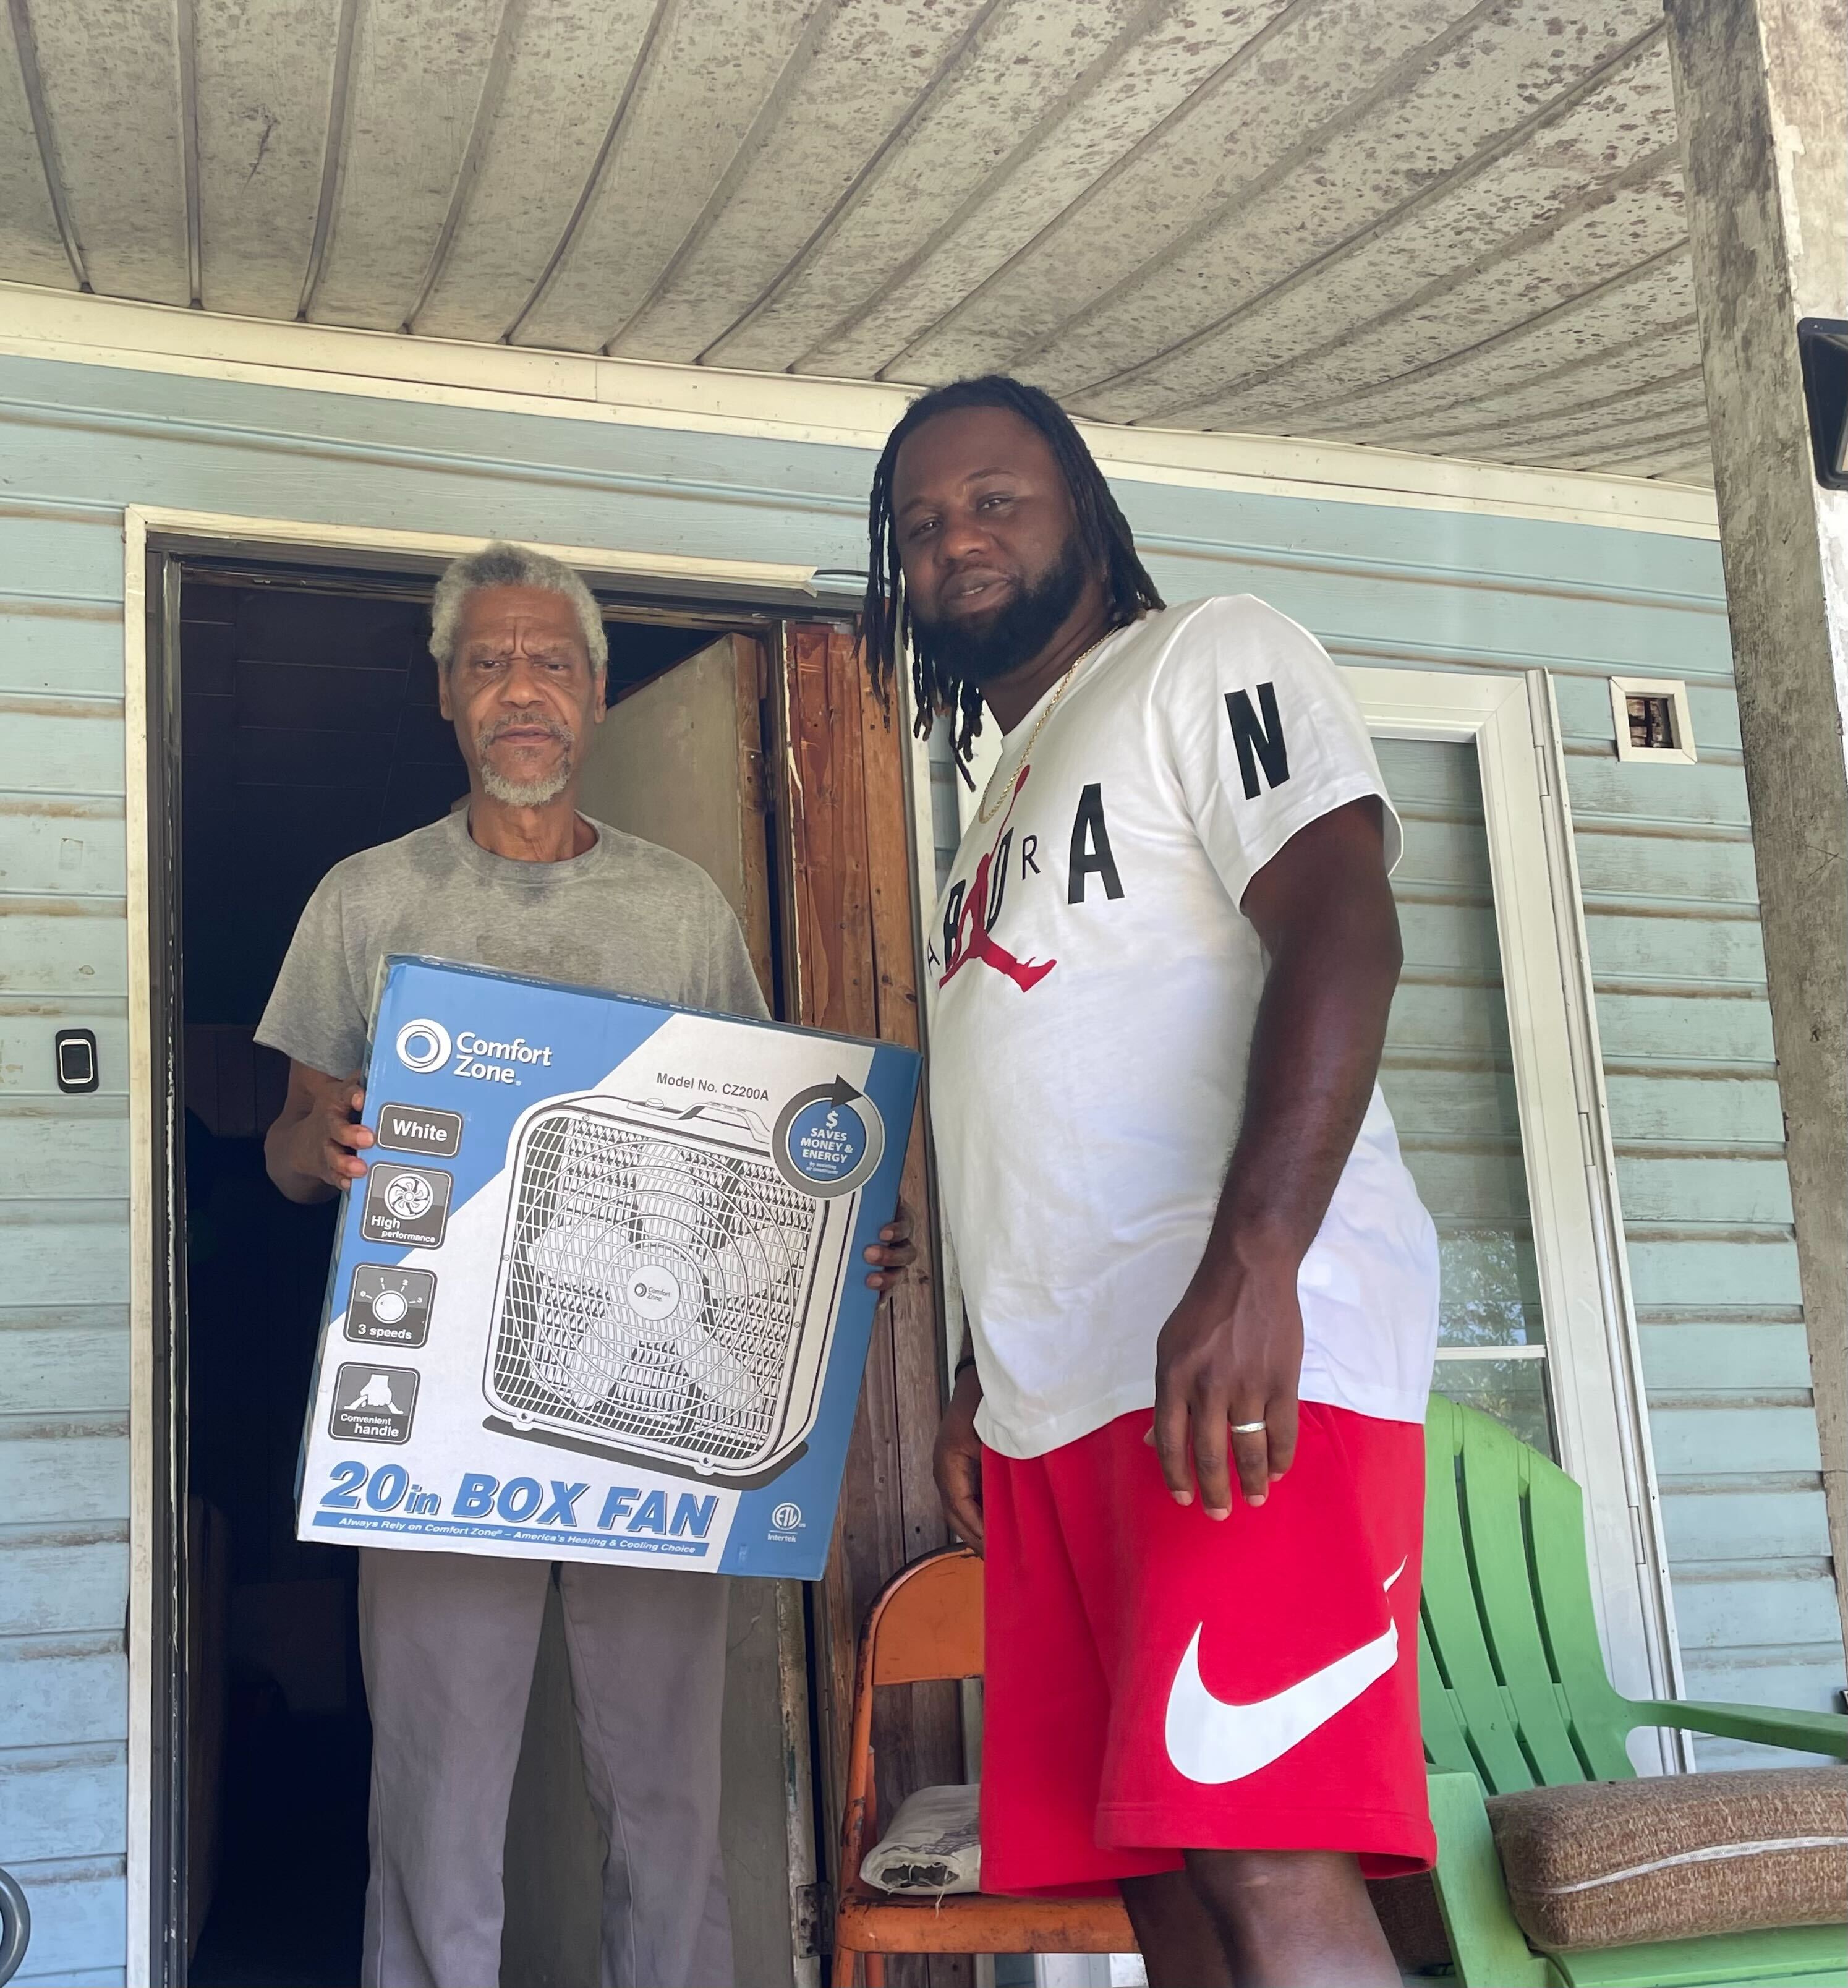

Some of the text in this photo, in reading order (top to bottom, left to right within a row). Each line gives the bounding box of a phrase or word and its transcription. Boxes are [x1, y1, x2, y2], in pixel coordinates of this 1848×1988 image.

[456, 1031, 553, 1067] Comfort
[657, 1072, 769, 1101] Model No. CZ200A
[393, 1119, 448, 1142] White
[811, 1128, 847, 1141] SAVES
[800, 1137, 853, 1153] MONEY &
[802, 1148, 848, 1163] ENERGY
[371, 1215, 401, 1230] High
[381, 1231, 435, 1243] performance
[649, 1287, 670, 1297] Comfort
[358, 1324, 412, 1340] 3 speeds
[341, 1414, 391, 1425] Convenient
[354, 1423, 399, 1437] handle
[319, 1460, 720, 1539] 20in BOX FAN
[339, 1518, 378, 1529] Always
[381, 1521, 406, 1530] Rely
[425, 1524, 469, 1535] Comfort
[513, 1531, 565, 1543] America's
[568, 1535, 611, 1548] Heating
[620, 1540, 658, 1552] Cooling
[661, 1543, 696, 1553] Choice
[767, 1534, 797, 1543] Intertek
